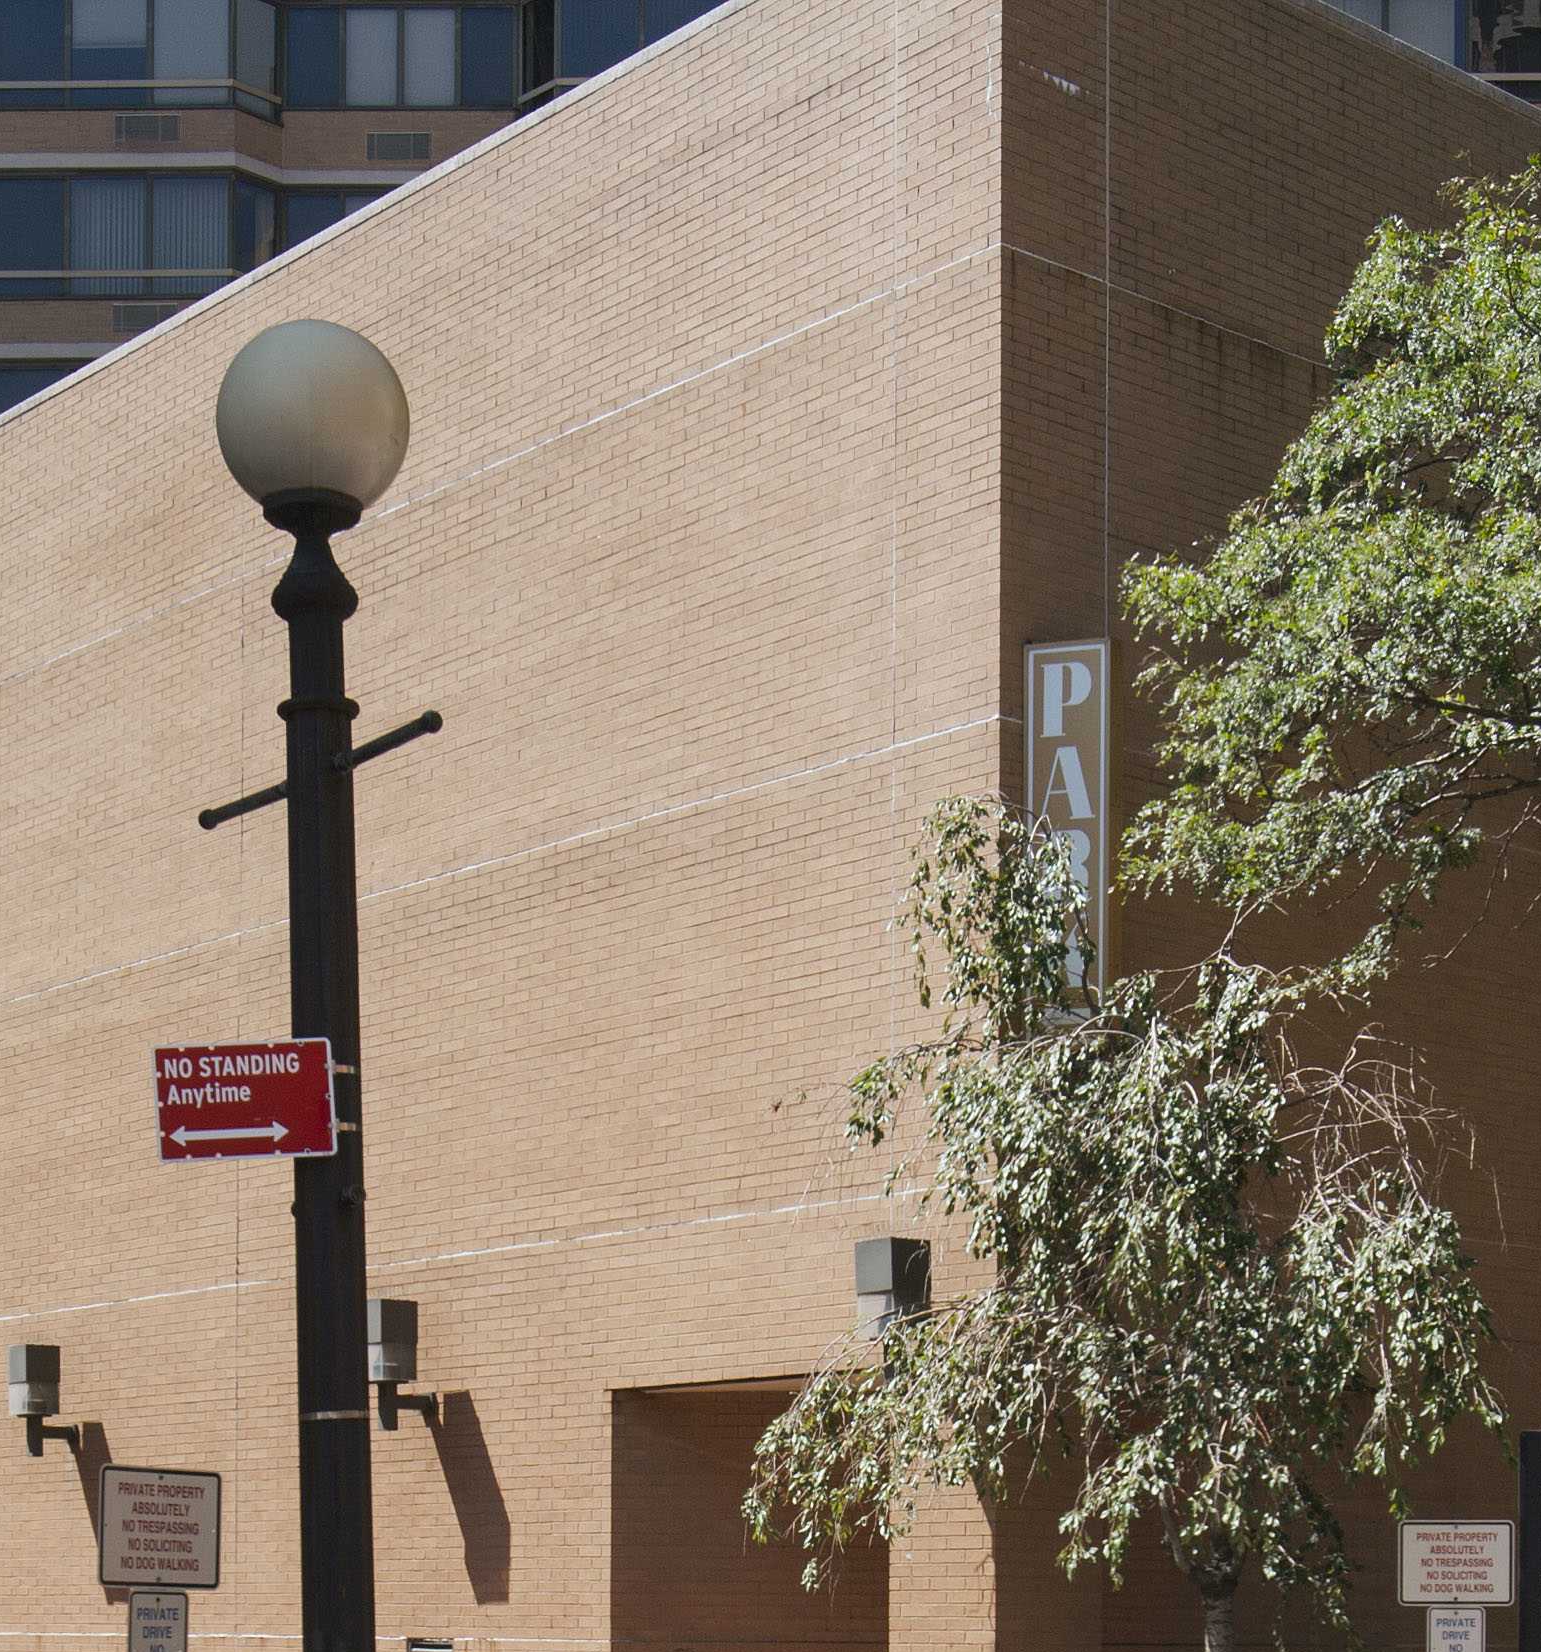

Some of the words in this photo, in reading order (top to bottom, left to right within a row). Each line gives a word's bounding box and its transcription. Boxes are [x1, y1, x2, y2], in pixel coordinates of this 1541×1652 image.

[164, 1057, 193, 1079] NO
[199, 1052, 301, 1077] STANDING
[167, 1082, 251, 1109] Anytime
[118, 1482, 156, 1497] PRIVATE
[157, 1484, 206, 1499] PROPERTY
[131, 1501, 191, 1517] ABSOLUTELY
[121, 1519, 135, 1532] NO
[137, 1519, 200, 1535] TRESPASSING
[1416, 1532, 1452, 1542] PRIVATE
[1453, 1532, 1499, 1542] PROPERTY
[128, 1537, 141, 1551] NO
[143, 1538, 193, 1553] SOLICITING
[1430, 1545, 1485, 1555] ABSOLUTELY
[120, 1556, 134, 1570] NO
[136, 1556, 156, 1570] DOG
[157, 1557, 200, 1572] WALKING
[1421, 1558, 1434, 1568] NO
[1435, 1558, 1494, 1568] TRESPASSING
[1426, 1571, 1440, 1581] NO
[1441, 1571, 1488, 1581] SOLICITING
[1420, 1583, 1433, 1593] NO
[1434, 1583, 1454, 1593] DOG
[1455, 1583, 1494, 1593] WALKING
[137, 1607, 180, 1621] PRIVATE
[1436, 1618, 1476, 1627] PRIVATE
[142, 1626, 172, 1639] DRIVE
[1442, 1630, 1470, 1640] DRIVE
[1449, 1644, 1464, 1652] NO
